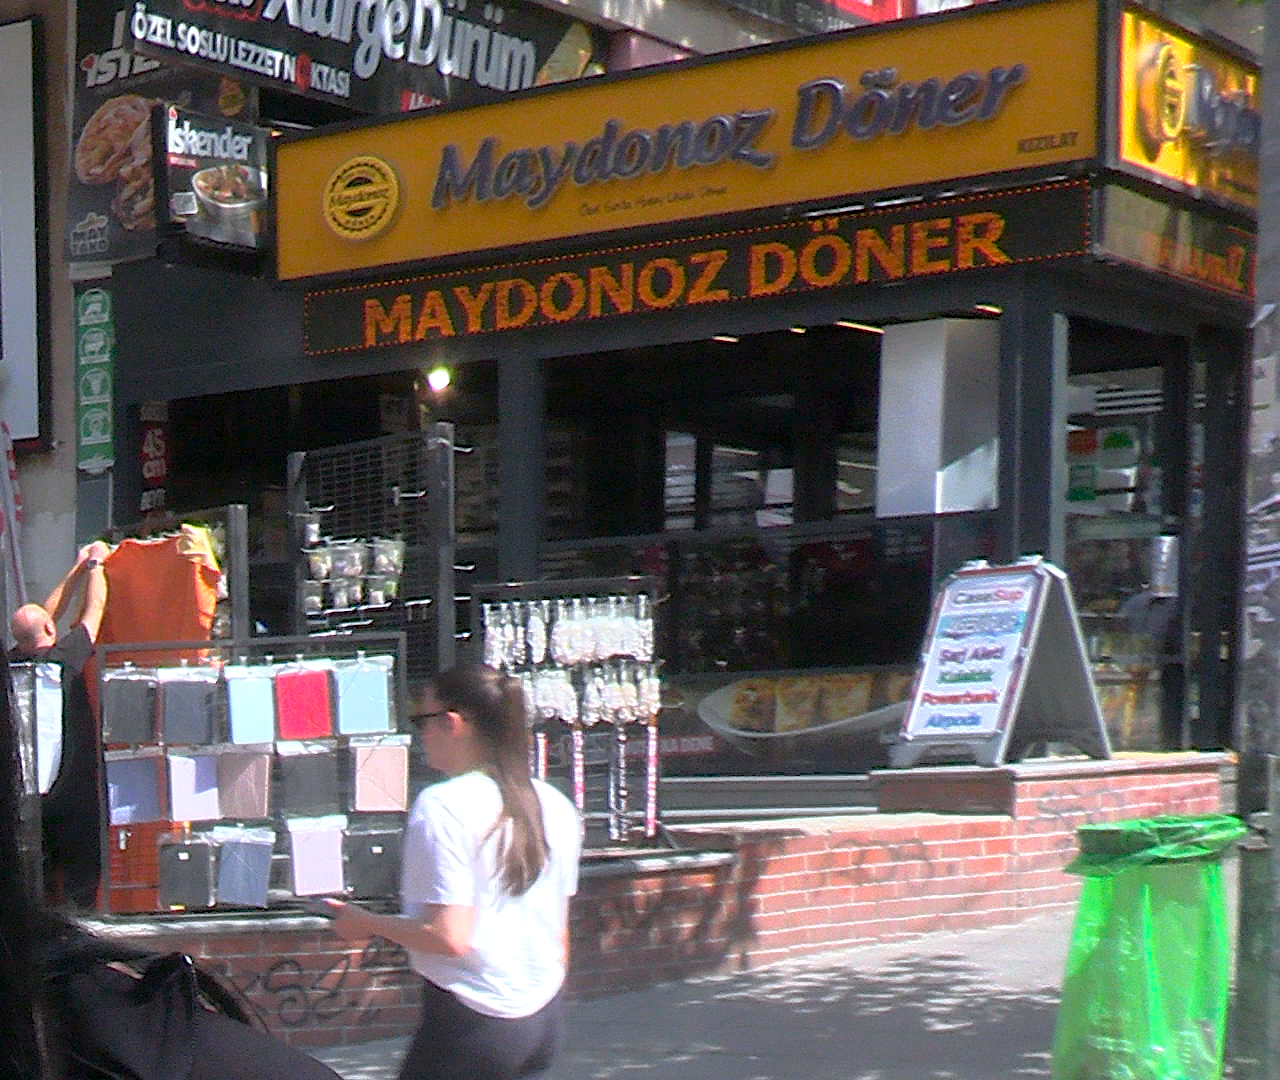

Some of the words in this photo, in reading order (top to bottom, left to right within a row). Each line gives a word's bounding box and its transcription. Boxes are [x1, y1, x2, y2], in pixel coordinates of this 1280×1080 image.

[131, 2, 176, 49] ÖZEL
[176, 19, 228, 63] SOSLU
[229, 37, 283, 78] LEZZET
[430, 107, 777, 211] Maydonoz
[790, 62, 1028, 152] Döner
[362, 249, 730, 348] MAYDONOZ
[747, 211, 1013, 298] DÖNER
